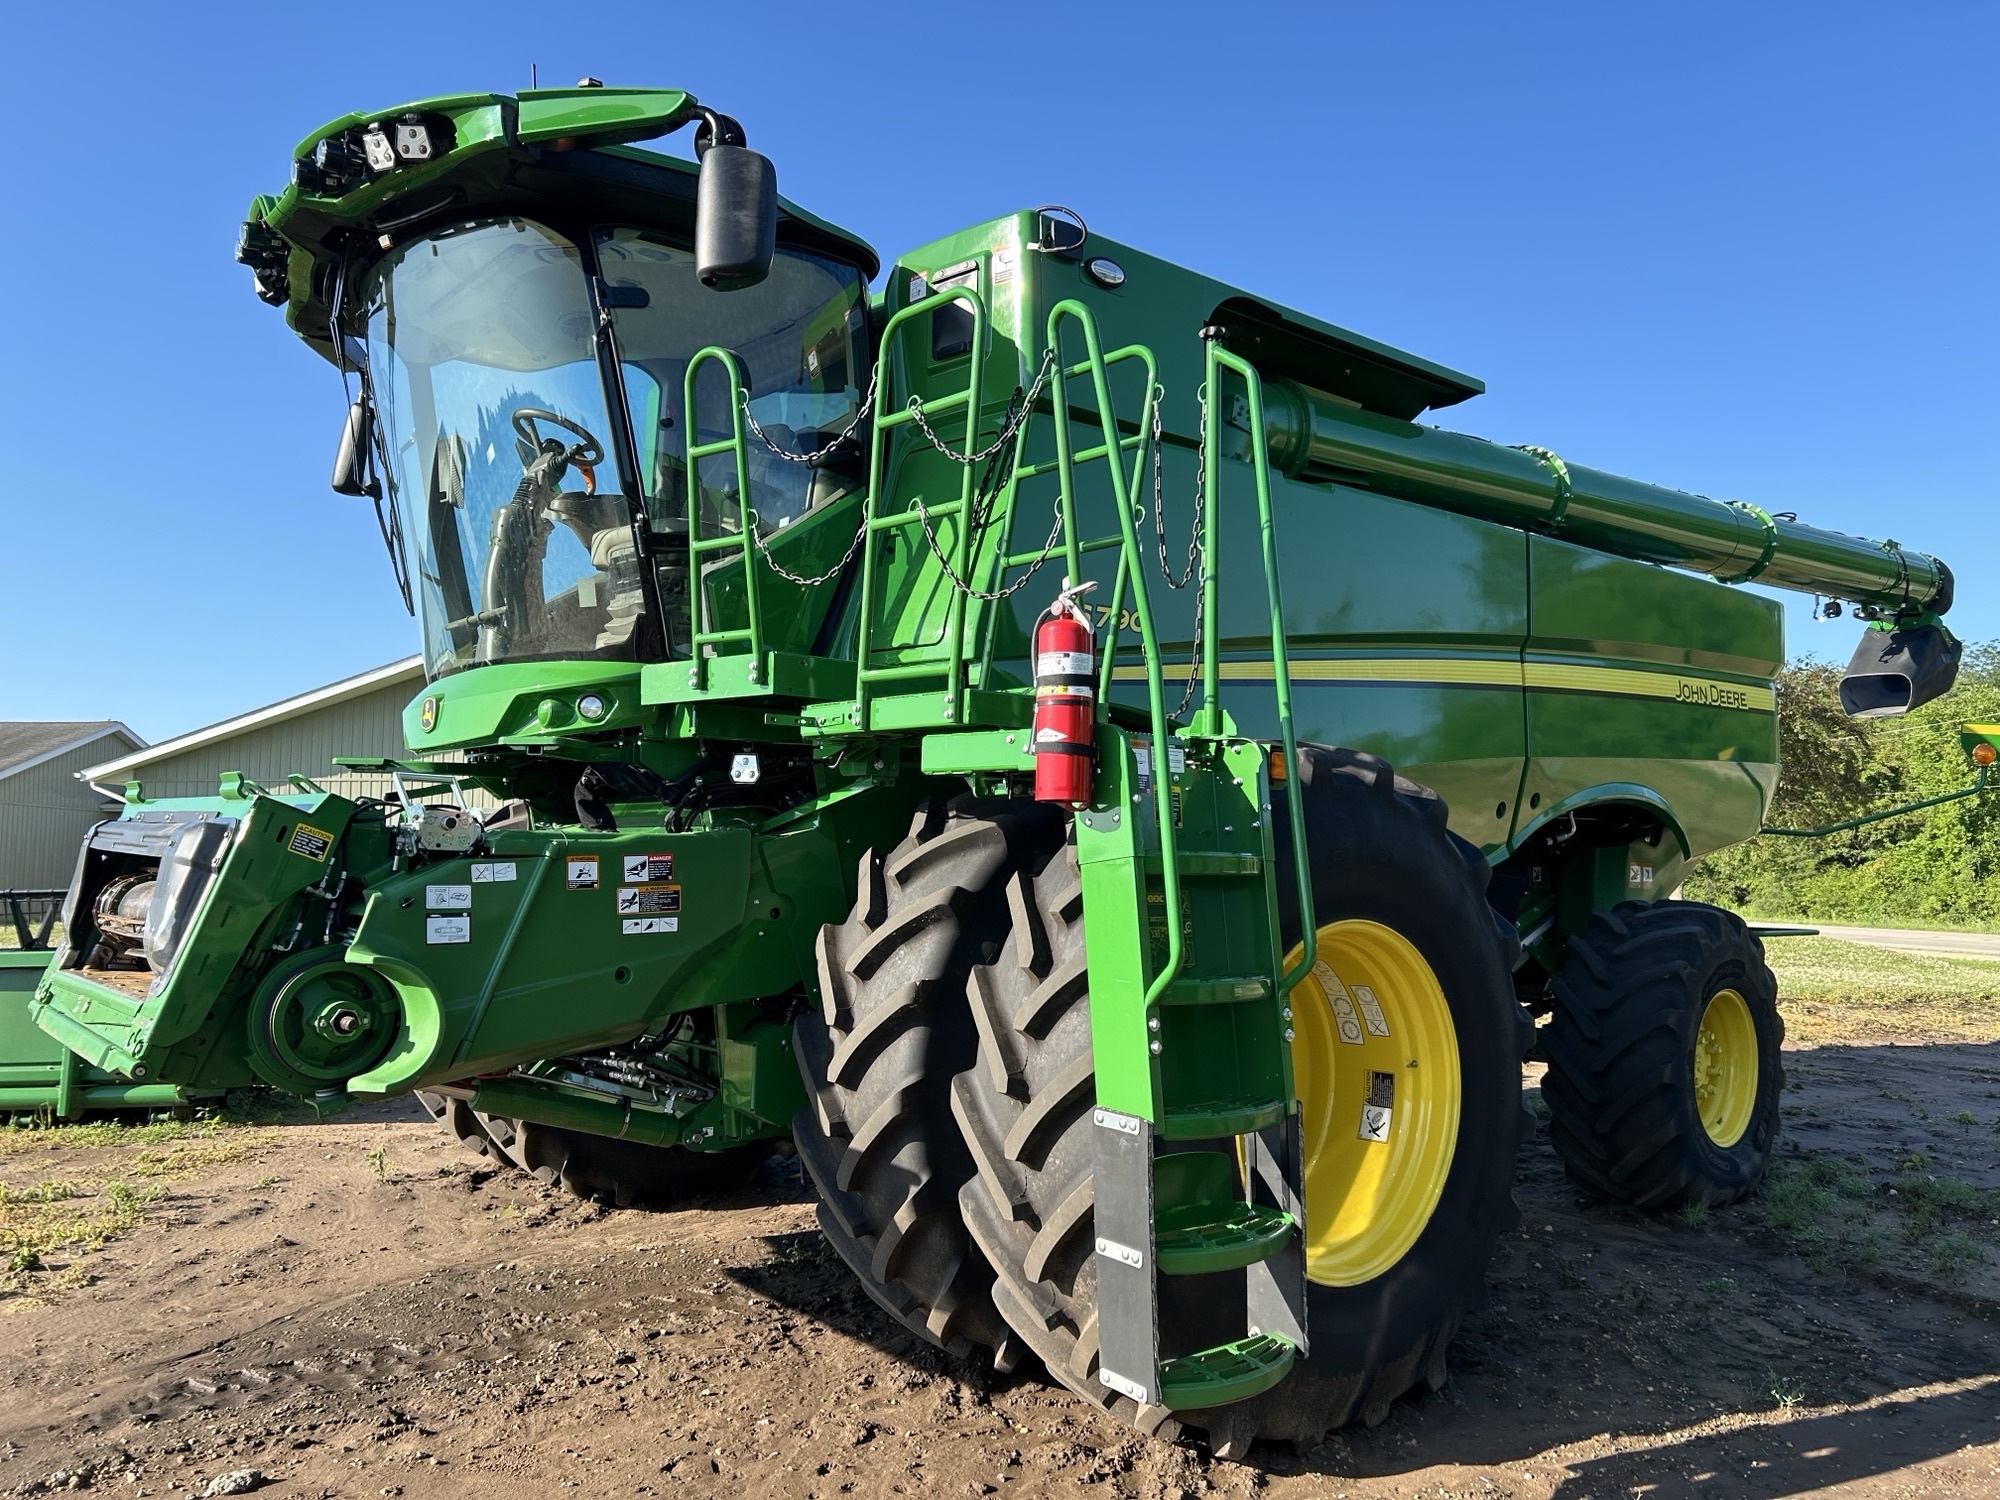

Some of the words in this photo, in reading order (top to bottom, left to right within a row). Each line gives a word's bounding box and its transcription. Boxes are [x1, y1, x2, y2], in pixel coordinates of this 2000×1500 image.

[1676, 680, 1708, 702] JOHN
[1709, 684, 1748, 707] DEERE
[303, 827, 332, 840] CAUTION
